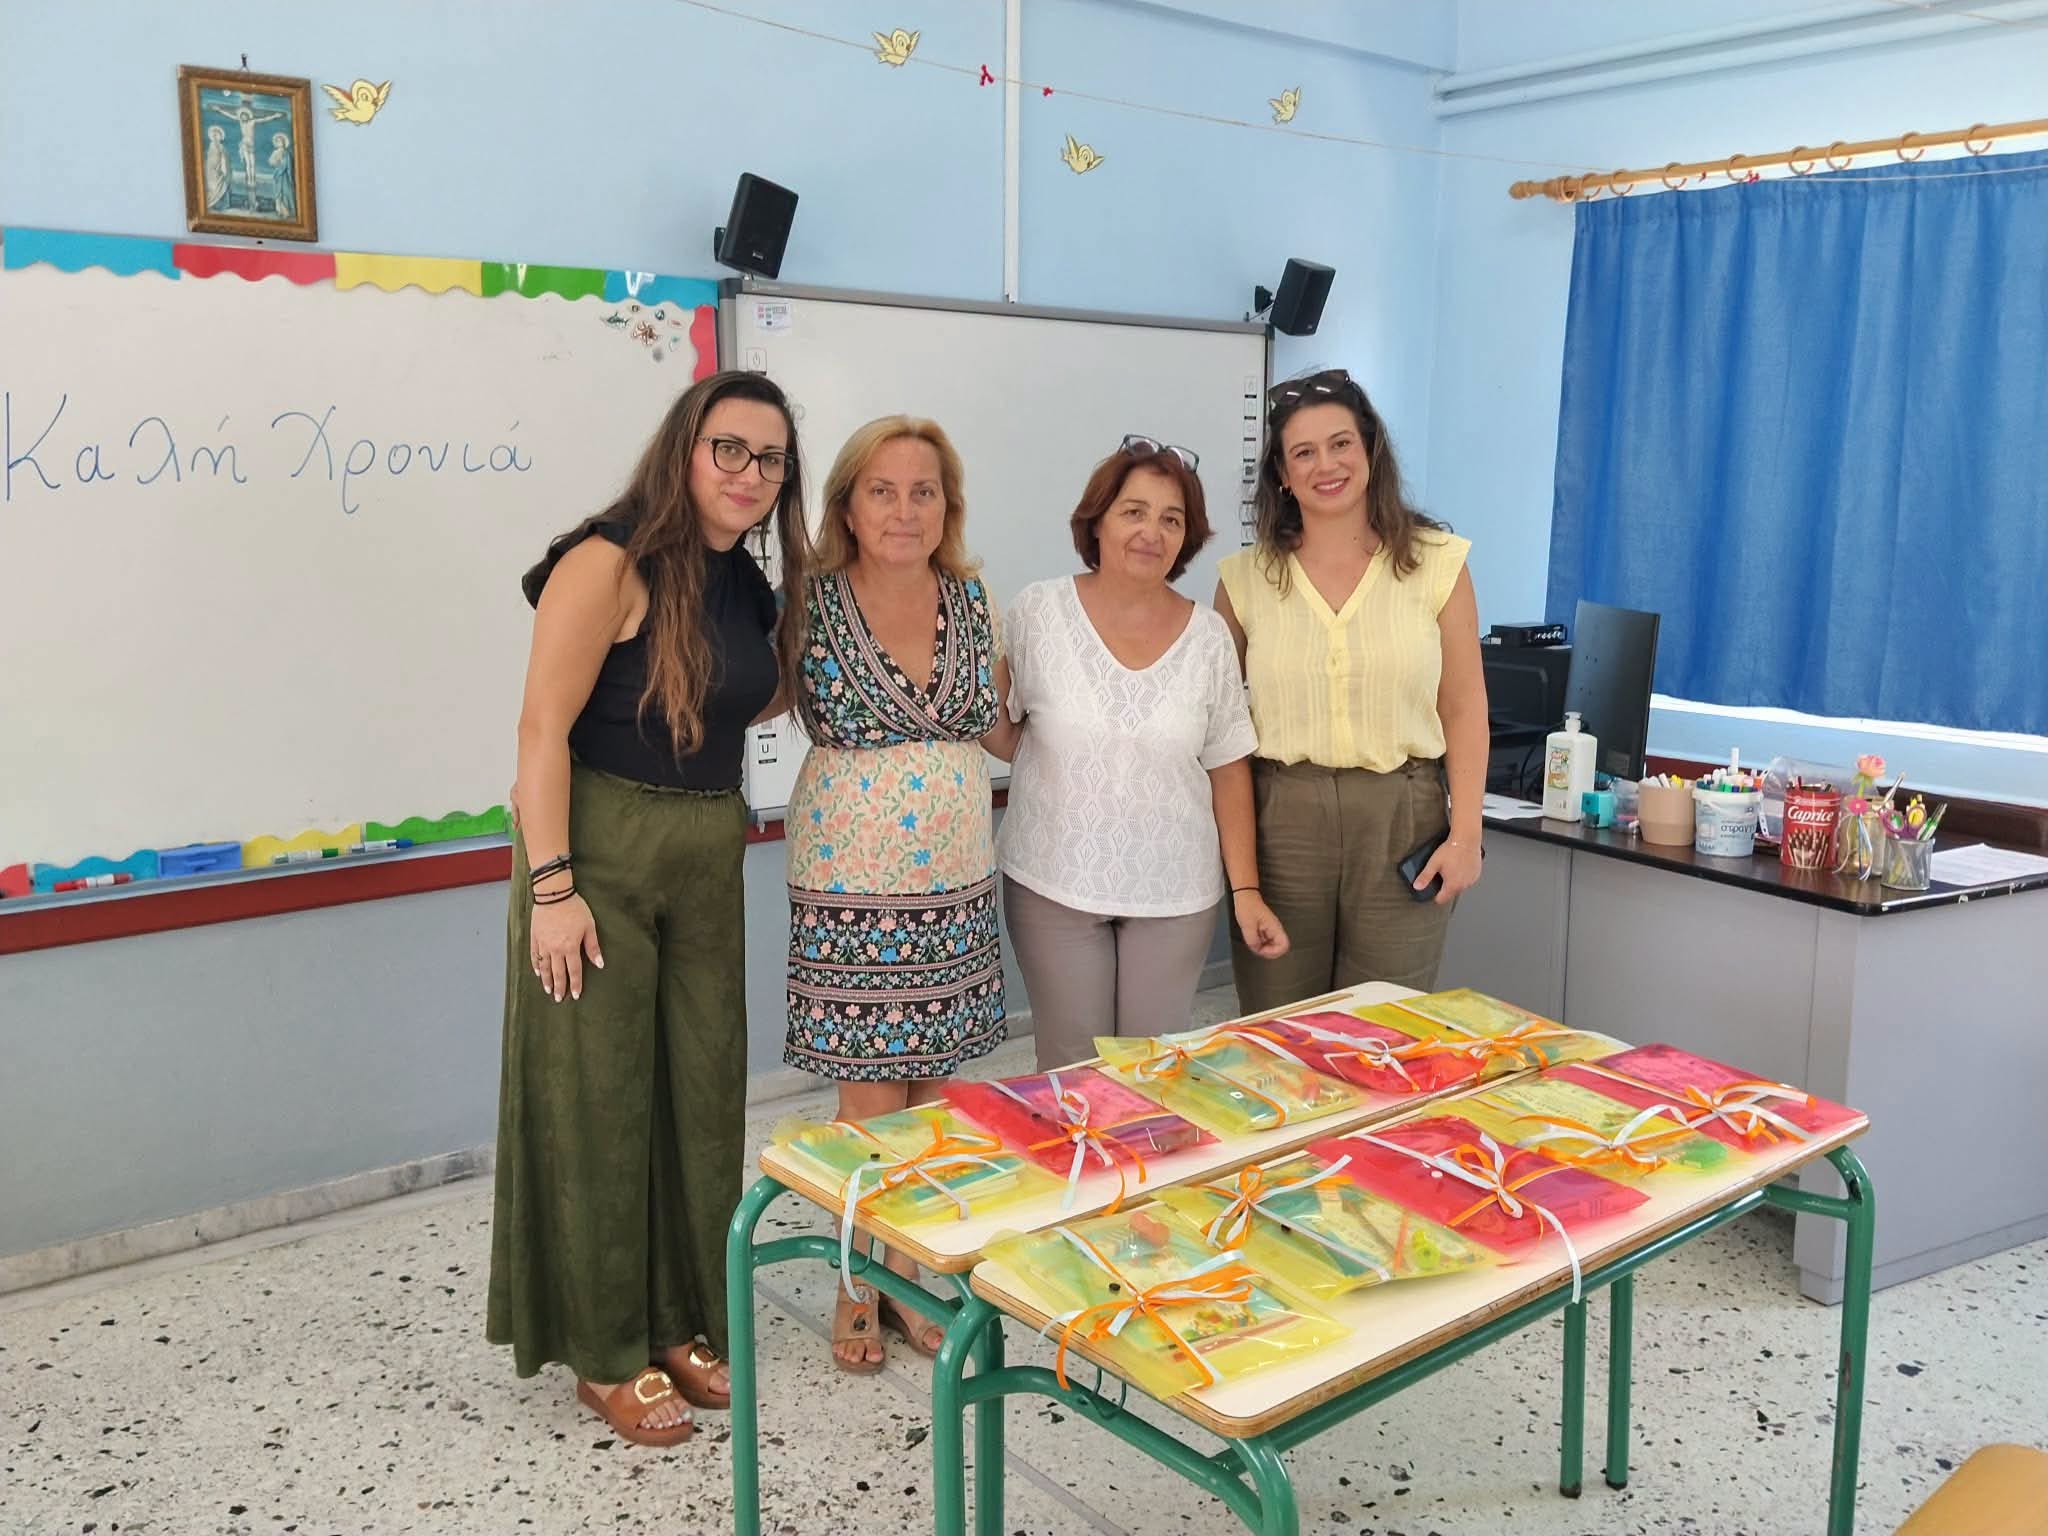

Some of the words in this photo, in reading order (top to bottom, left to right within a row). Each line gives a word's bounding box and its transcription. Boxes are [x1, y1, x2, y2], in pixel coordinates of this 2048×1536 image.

[6, 391, 248, 501] Καλή
[271, 405, 532, 515] Χρονιά
[1787, 805, 1834, 823] Caprice
